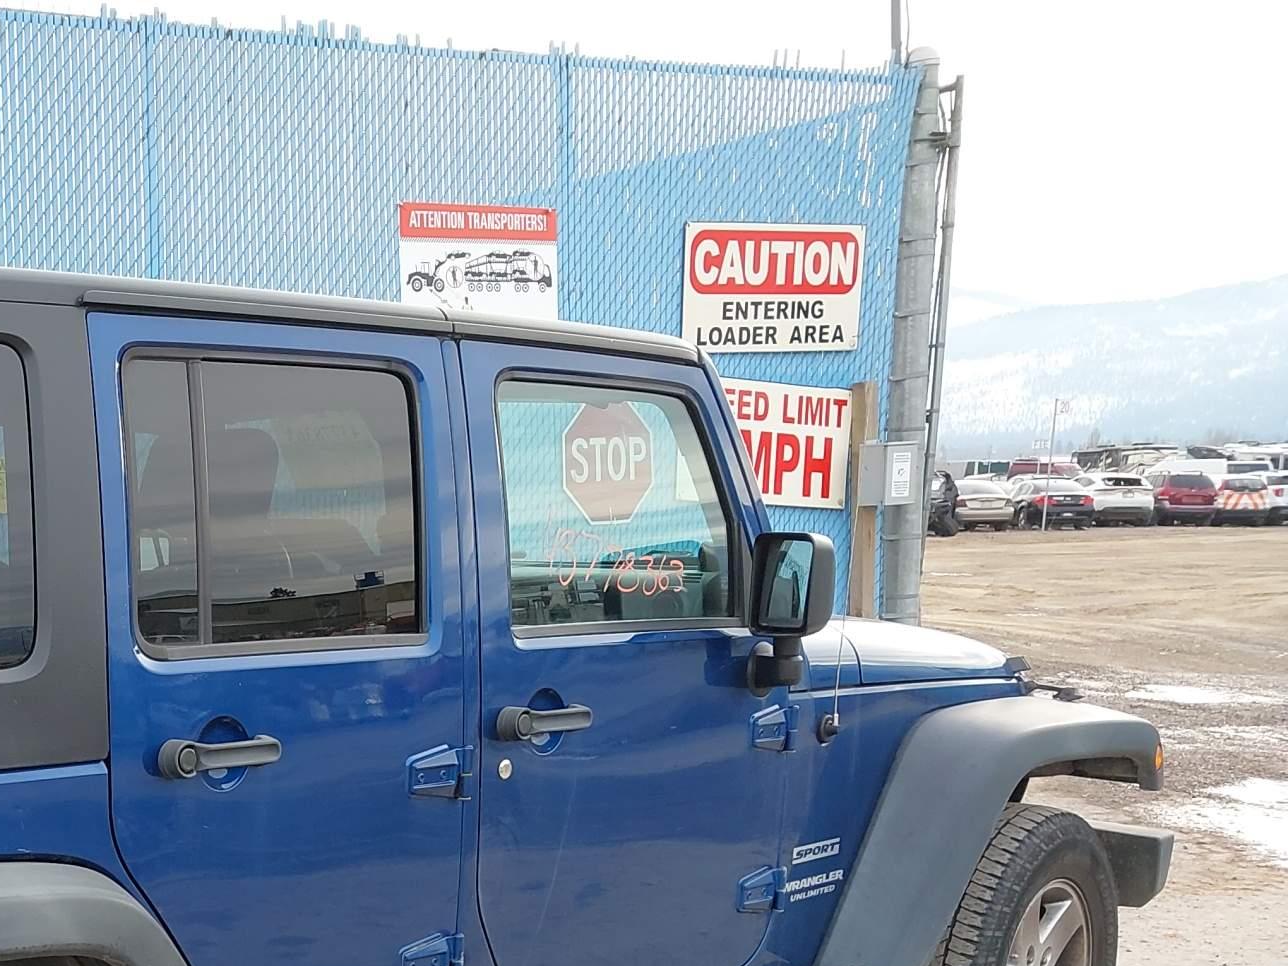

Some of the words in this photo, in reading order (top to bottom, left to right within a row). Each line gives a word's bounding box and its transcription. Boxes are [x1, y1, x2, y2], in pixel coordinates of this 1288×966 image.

[409, 210, 465, 229] ATTENTION
[467, 211, 547, 232] TRANSPORTERS!
[694, 239, 856, 286] CAUTION
[722, 300, 824, 320] ENTERING
[697, 326, 777, 346] LOADER
[789, 325, 844, 344] AREA
[782, 394, 848, 428] LIMIT
[570, 436, 647, 484] STOP
[740, 429, 833, 499] MPH
[795, 842, 838, 859] SPORT
[784, 869, 844, 892] WRANGLER
[789, 884, 836, 903] UNLIMITED
